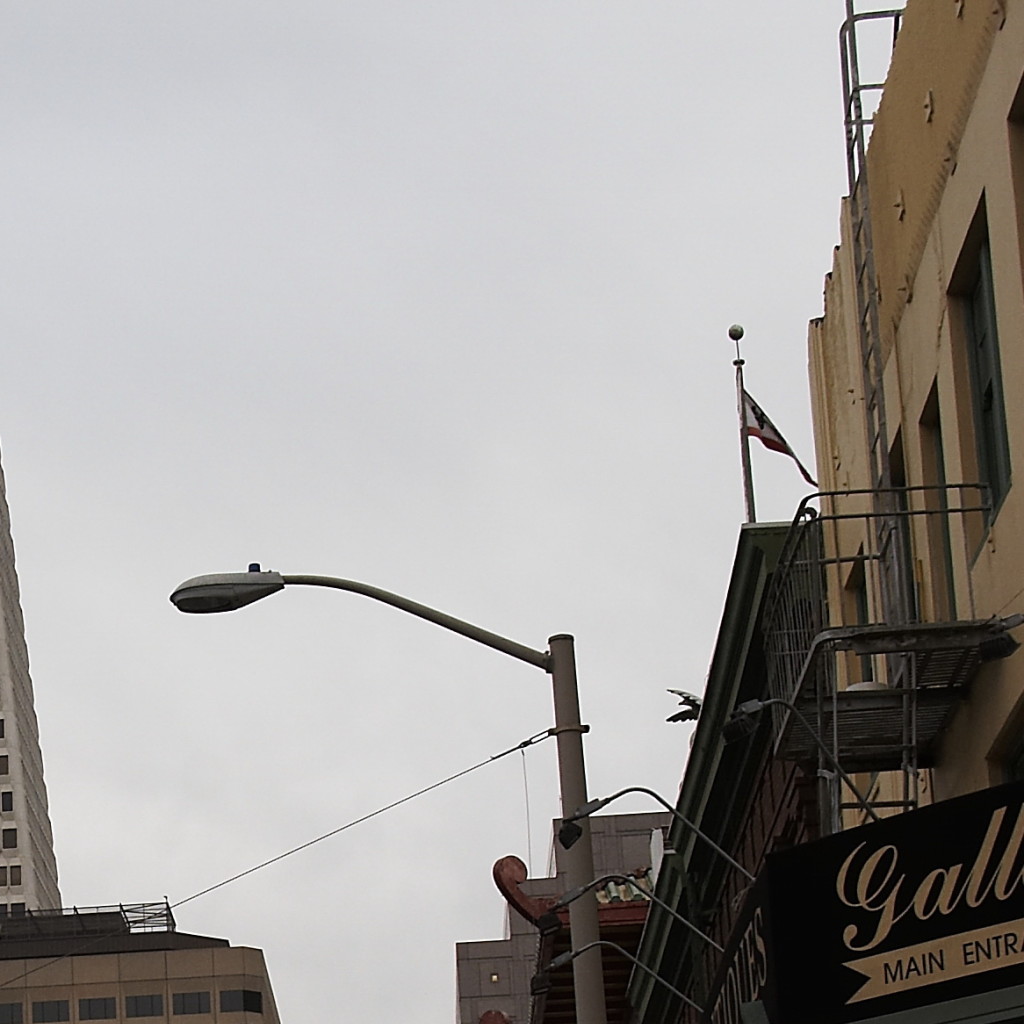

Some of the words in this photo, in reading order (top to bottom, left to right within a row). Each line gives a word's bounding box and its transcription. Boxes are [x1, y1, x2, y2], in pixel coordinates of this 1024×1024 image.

[836, 802, 1024, 951] Gall
[883, 950, 945, 984] MAIN
[963, 932, 1024, 965] ENTR
